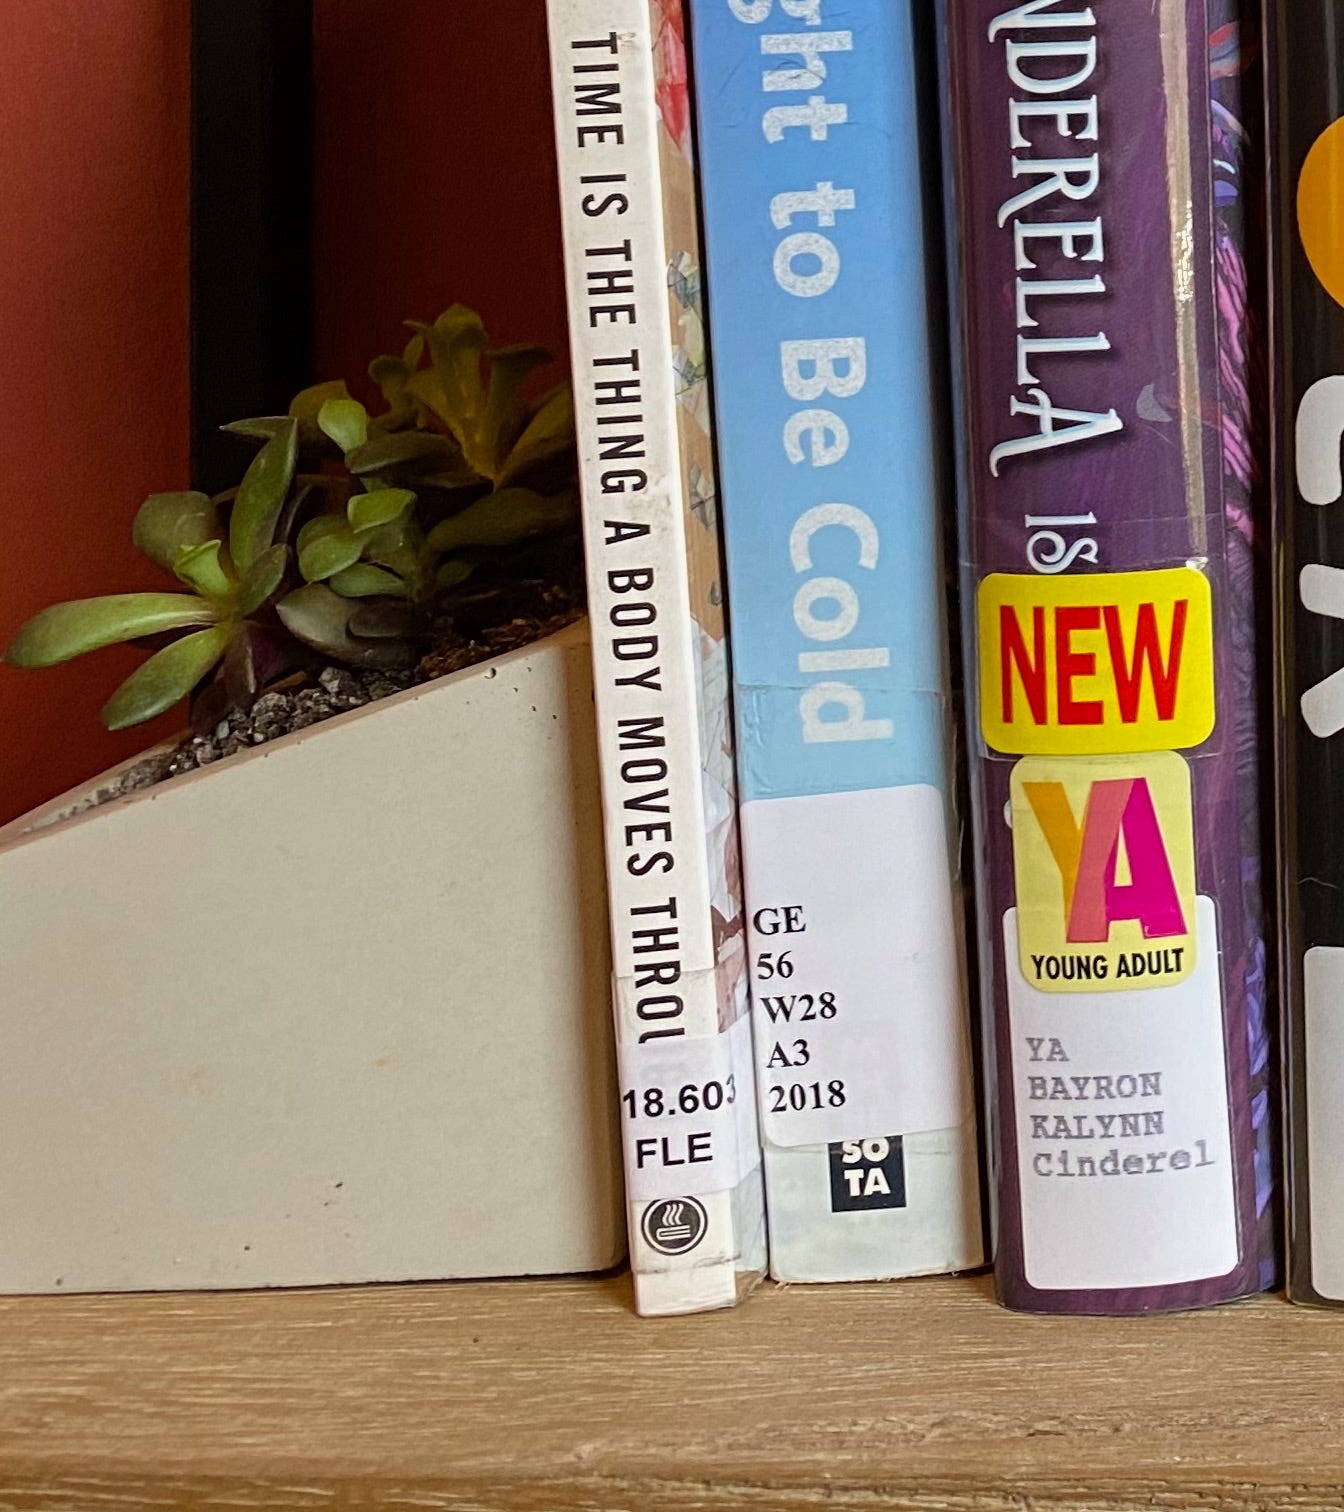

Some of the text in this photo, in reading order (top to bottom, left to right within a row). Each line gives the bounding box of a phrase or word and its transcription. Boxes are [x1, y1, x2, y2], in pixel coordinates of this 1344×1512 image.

[571, 31, 625, 148] TIME
[579, 173, 629, 217] IS
[770, 181, 856, 298] to
[585, 239, 637, 328] THE
[780, 337, 866, 467] Be
[592, 349, 649, 495] THING
[603, 520, 651, 546] A
[1024, 511, 1100, 574] IS
[607, 568, 662, 692] BODY
[789, 503, 895, 745] Cold
[1000, 599, 1188, 725] NEW
[616, 718, 674, 877] MOVES
[1021, 776, 1189, 944] YA
[754, 905, 807, 935] GE
[757, 951, 794, 979] 56
[1031, 947, 1184, 981] YOUNG ADULT
[762, 991, 838, 1024] W28
[768, 1040, 811, 1068] A3
[1026, 1038, 1070, 1063] YA
[769, 1080, 847, 1113] 2018
[1028, 1072, 1162, 1100] BAYRON
[1030, 1110, 1166, 1140] KALYNN
[636, 1132, 713, 1169] FLE
[842, 1137, 890, 1164] SO
[1032, 1140, 1216, 1177] Cinderel
[844, 1167, 891, 1197] TA
